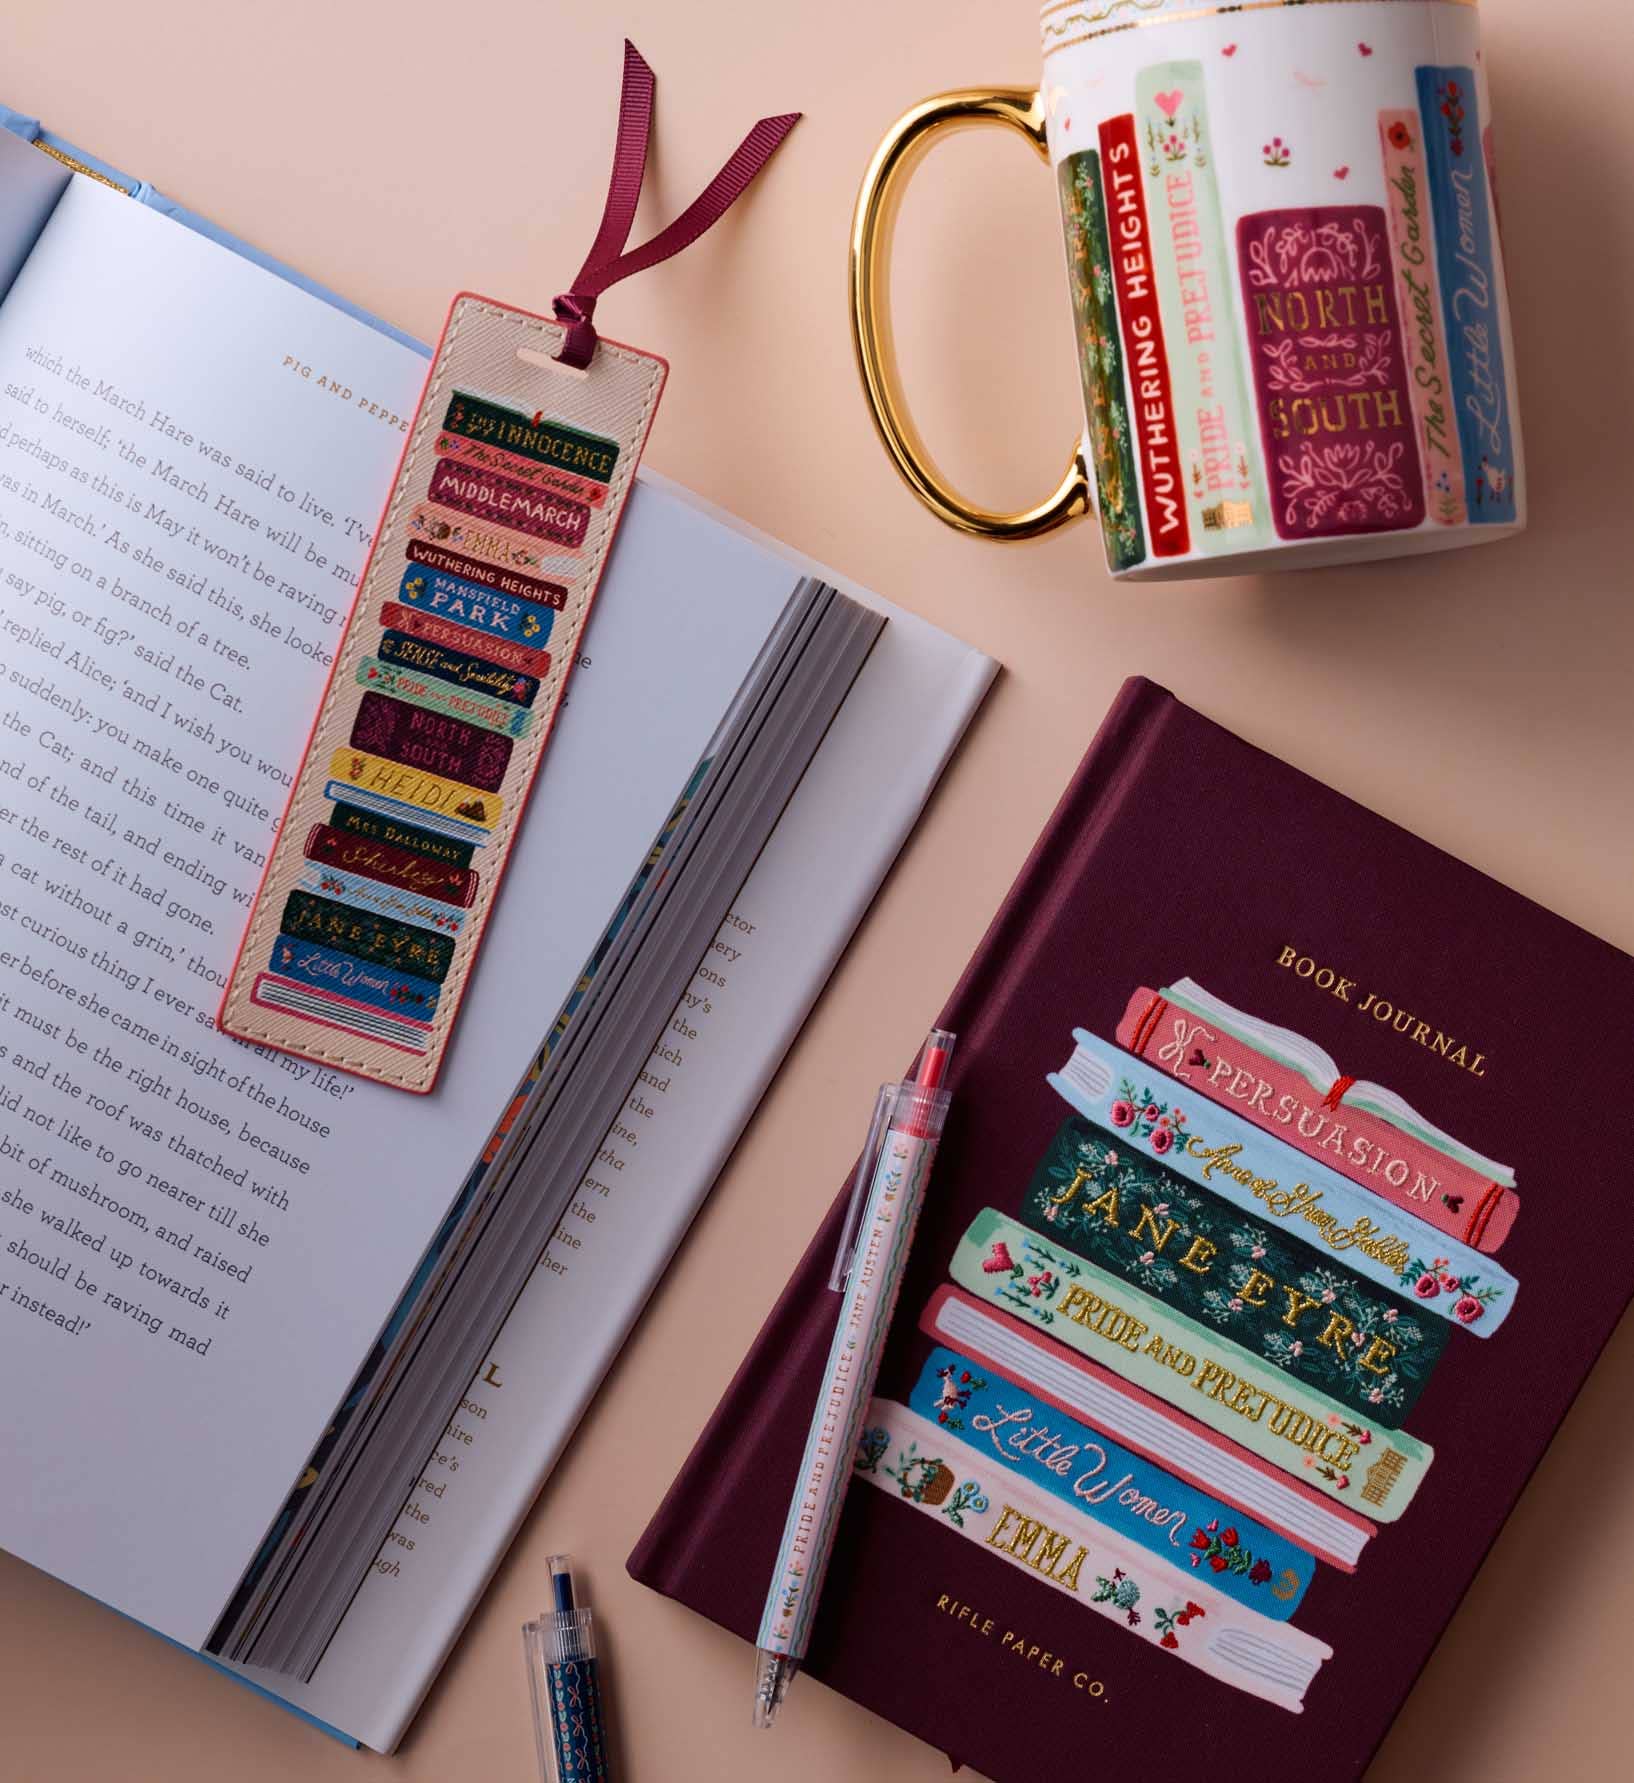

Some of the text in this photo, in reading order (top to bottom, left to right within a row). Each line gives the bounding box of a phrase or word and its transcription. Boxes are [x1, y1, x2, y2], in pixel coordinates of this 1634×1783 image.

[1110, 142, 1179, 533] WUTHERING HEIGHTS
[1256, 284, 1389, 336] NORTH
[1391, 165, 1451, 457] The Secret Garden
[1452, 168, 1501, 454] Little Women
[282, 355, 409, 432] PIG AND PEPPE
[1303, 351, 1358, 371] AND
[26, 346, 335, 527] which the March Hare was said to live.
[498, 424, 612, 474] INNOCENCE
[1197, 405, 1234, 491] PRIDE
[1270, 389, 1403, 438] SOUTH
[439, 475, 582, 532] MIDDLEMARCH
[14, 529, 250, 670] sitting on a branch of a tree.
[413, 546, 561, 606] WUTHERING HEIGHTS
[429, 591, 511, 632] PARK
[434, 577, 521, 615] MANSFIELD
[423, 622, 522, 664] PERSUASION
[401, 742, 463, 773] SOUTH
[410, 711, 472, 745] NORTH
[369, 766, 456, 809] HEIDI
[16, 816, 215, 936] the rest of it had gone.
[342, 847, 444, 891] Shirley
[21, 916, 195, 1016] curious thing I ever
[19, 955, 76, 1000] before
[75, 993, 113, 1019] she
[111, 1013, 160, 1046] came
[160, 1035, 179, 1058] in
[178, 1048, 227, 1082] sight
[225, 1074, 250, 1093] of
[246, 1083, 276, 1109] the
[276, 1096, 330, 1138] house
[673, 1018, 697, 1040] the
[1276, 945, 1487, 1078] BOOK JOURNAL
[13, 1006, 312, 1176] must be the right house, because
[282, 1055, 311, 1082] my
[629, 1097, 654, 1120] the
[640, 1072, 671, 1093] and
[9, 1054, 289, 1211] and the roof was thatched with
[1186, 1136, 1252, 1181] Anne
[1207, 1055, 1441, 1204] PERSUASION
[0, 1134, 255, 1284] bit of mushroom, and raised
[22, 1107, 272, 1248] not like to go nearer till she
[571, 1200, 596, 1224] the
[0, 1188, 232, 1320] she walked up towards it
[541, 1252, 568, 1275] her
[849, 1228, 883, 1328] JANE AUSTEN
[1050, 1166, 1398, 1376] JANE EYRE
[6, 1240, 212, 1356] should be raving mad
[484, 1362, 502, 1388] L
[1056, 1282, 1361, 1472] PRIDE AND PREJUDICE
[793, 1354, 853, 1554] PRIDE AND PREJUDICE
[972, 1403, 1188, 1547] Little Women
[405, 1503, 430, 1527] the
[984, 1503, 1090, 1592] EMMA
[936, 1593, 1111, 1704] RIFLE PAPER CO.
